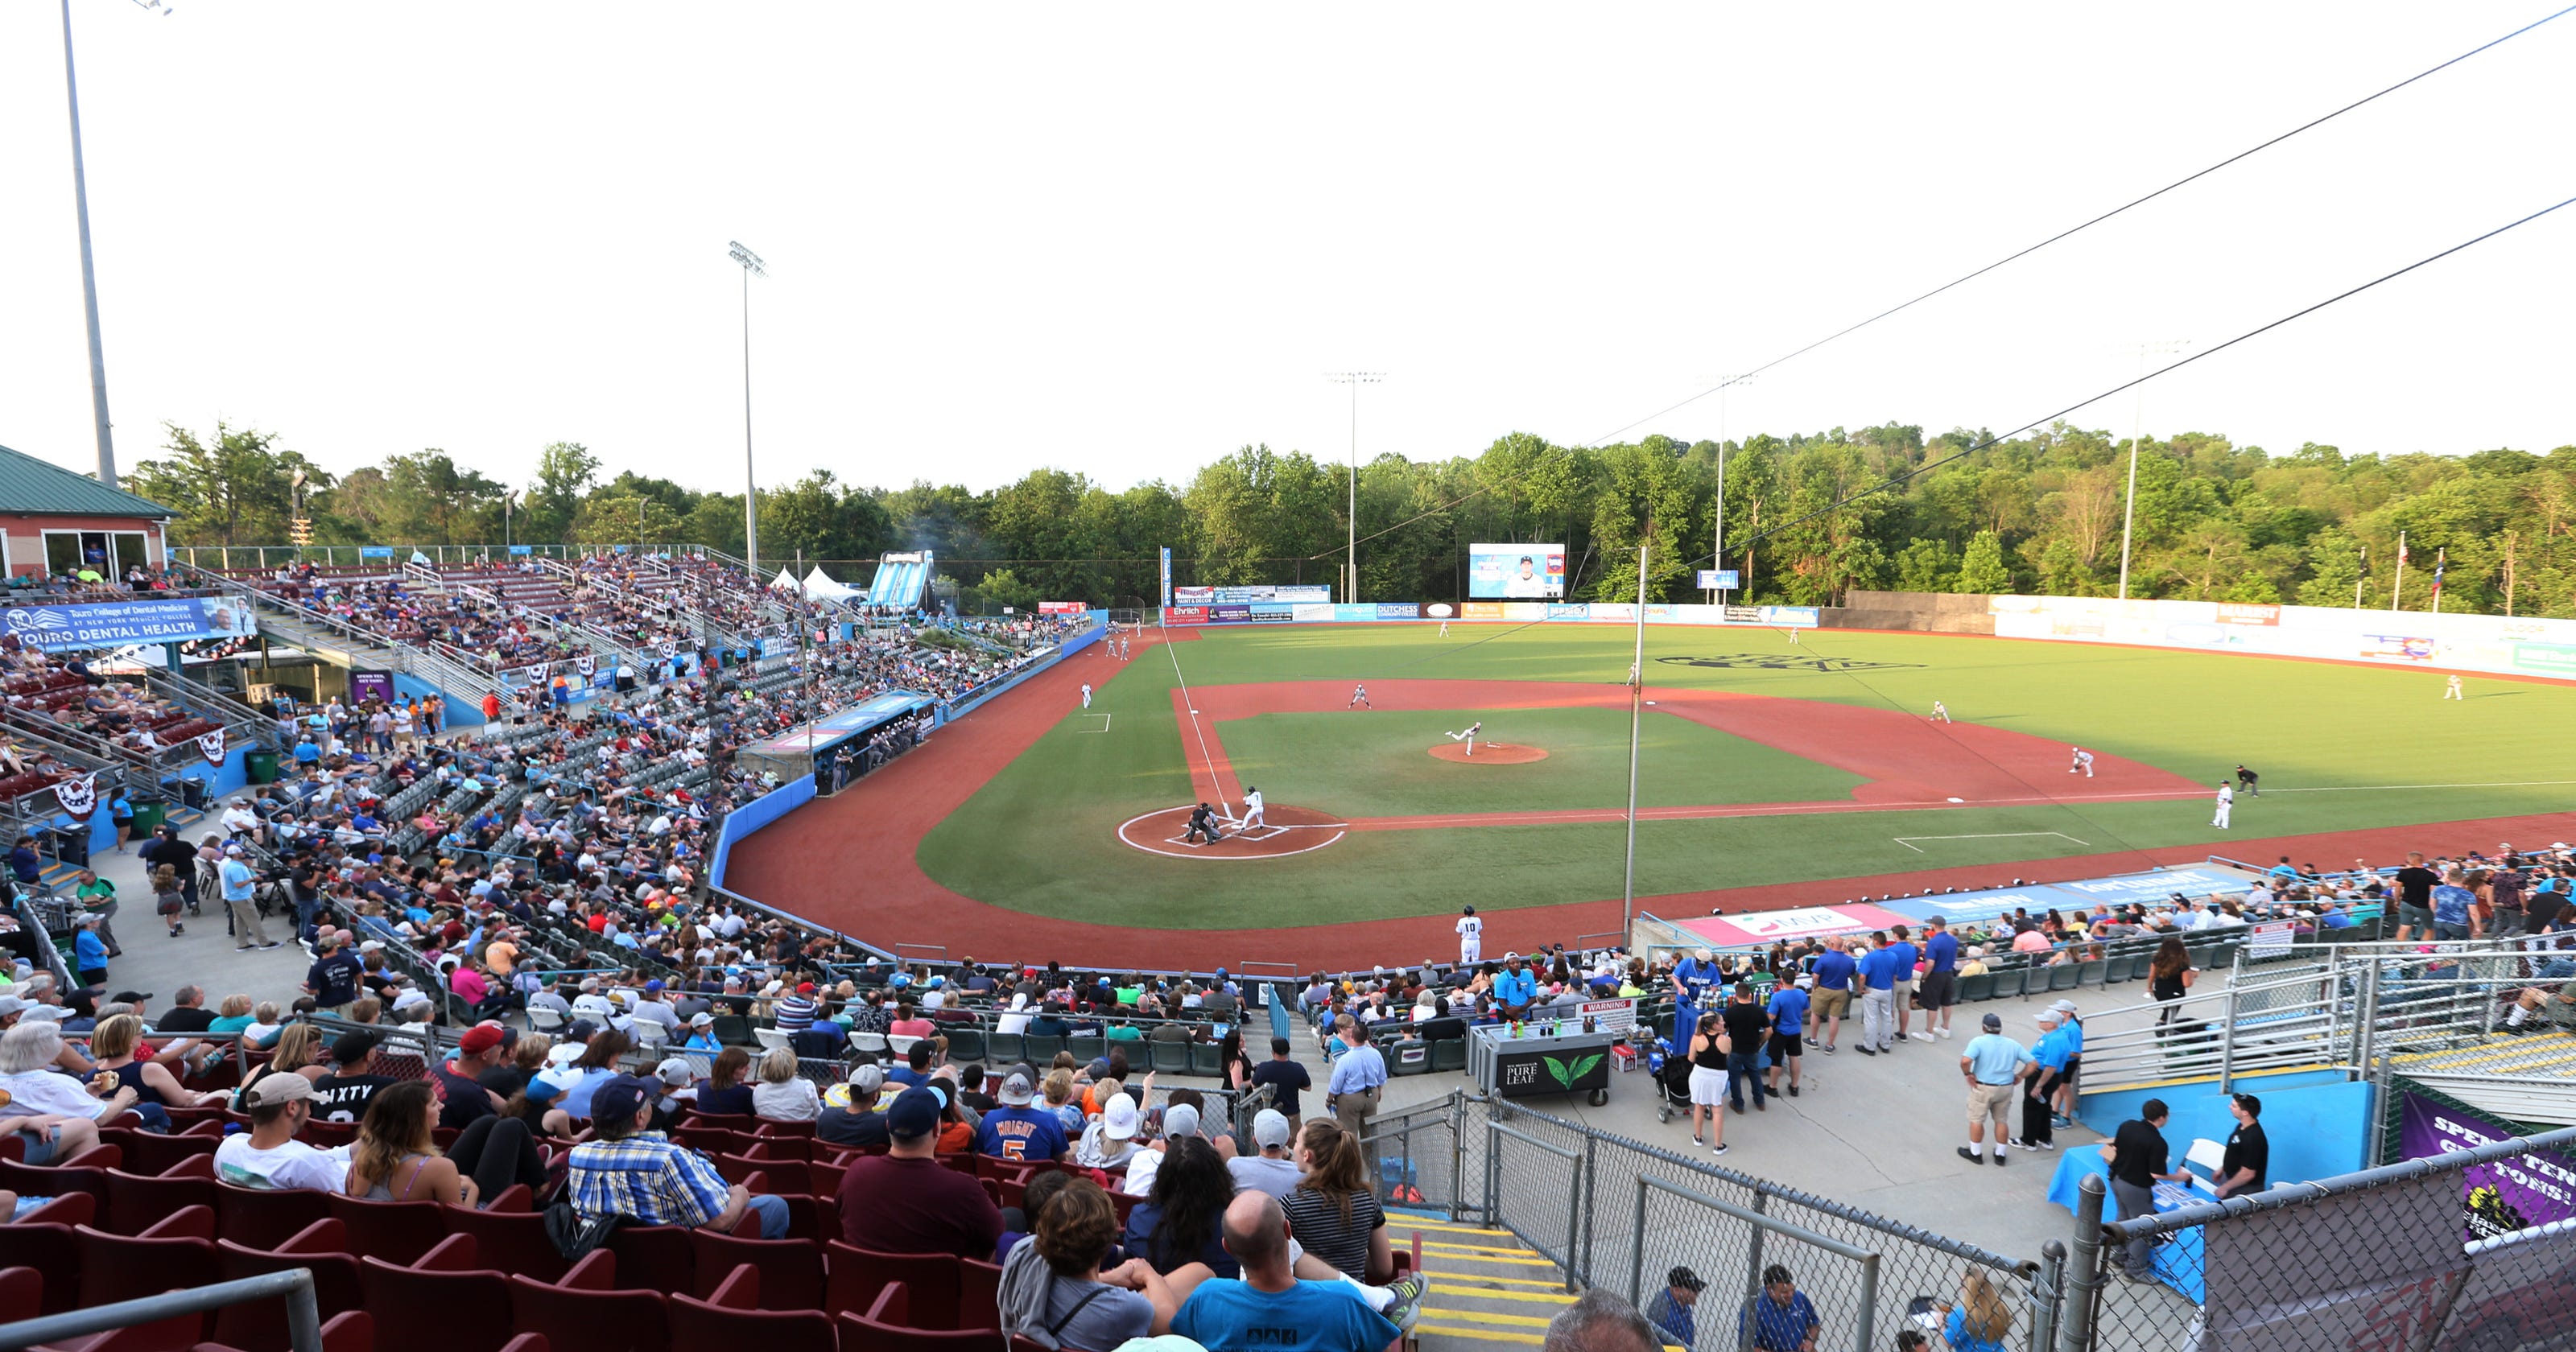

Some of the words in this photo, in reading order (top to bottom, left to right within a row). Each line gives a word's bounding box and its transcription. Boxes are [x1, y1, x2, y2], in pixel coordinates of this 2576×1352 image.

[69, 609, 92, 618] Touro
[93, 608, 122, 617] College
[122, 606, 131, 615] of
[132, 605, 156, 614] Dental
[158, 604, 189, 612] Medicine
[1173, 607, 1197, 615] Ehrlich
[2219, 605, 2279, 618] MARIST
[78, 626, 140, 641] DENTAL
[142, 622, 196, 636] HEALTH
[1773, 914, 1833, 927] MVP
[1465, 923, 1476, 932] 10
[1587, 1000, 1626, 1012] WARNING
[1507, 1066, 1537, 1077] PURE
[1507, 1075, 1534, 1085] LEAF
[996, 1120, 1037, 1139] WRIGHT
[1003, 1140, 1026, 1161] 5
[2493, 1161, 2571, 1206] TONS!
